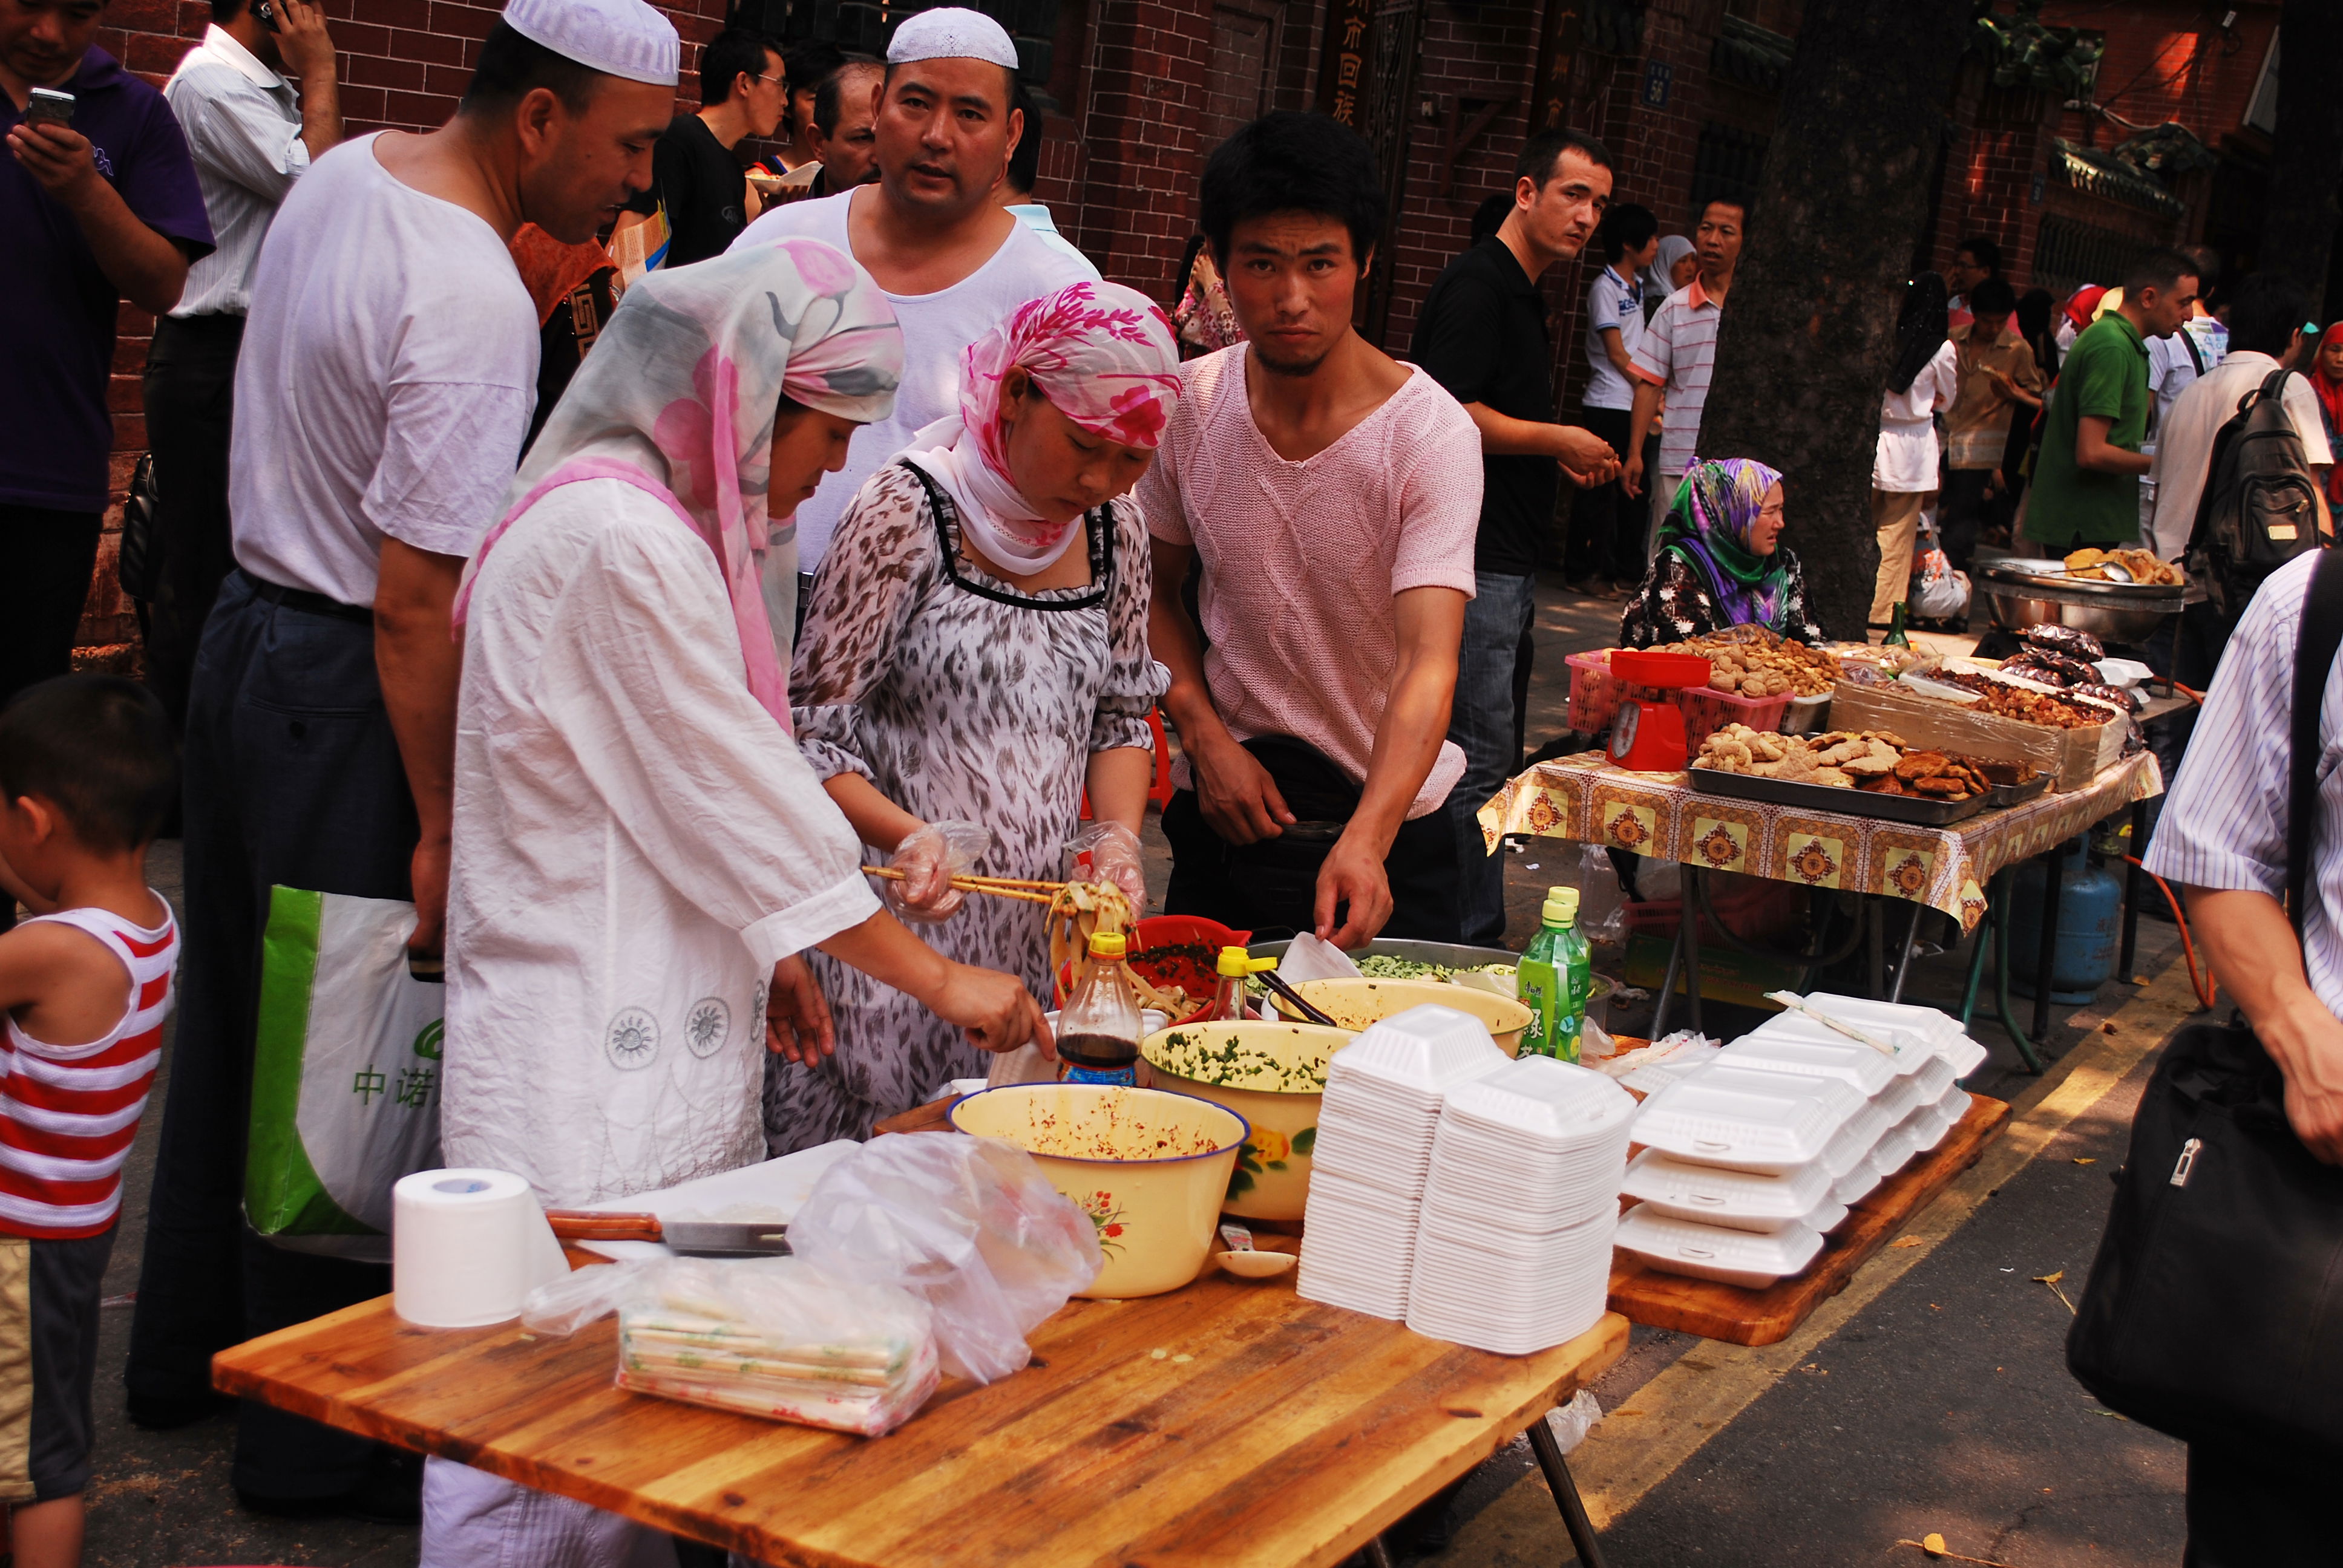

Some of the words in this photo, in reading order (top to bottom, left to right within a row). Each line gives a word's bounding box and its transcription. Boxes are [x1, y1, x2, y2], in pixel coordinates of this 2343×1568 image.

[1545, 7, 1578, 129] 广州市
[353, 1064, 440, 1108] 中诺
